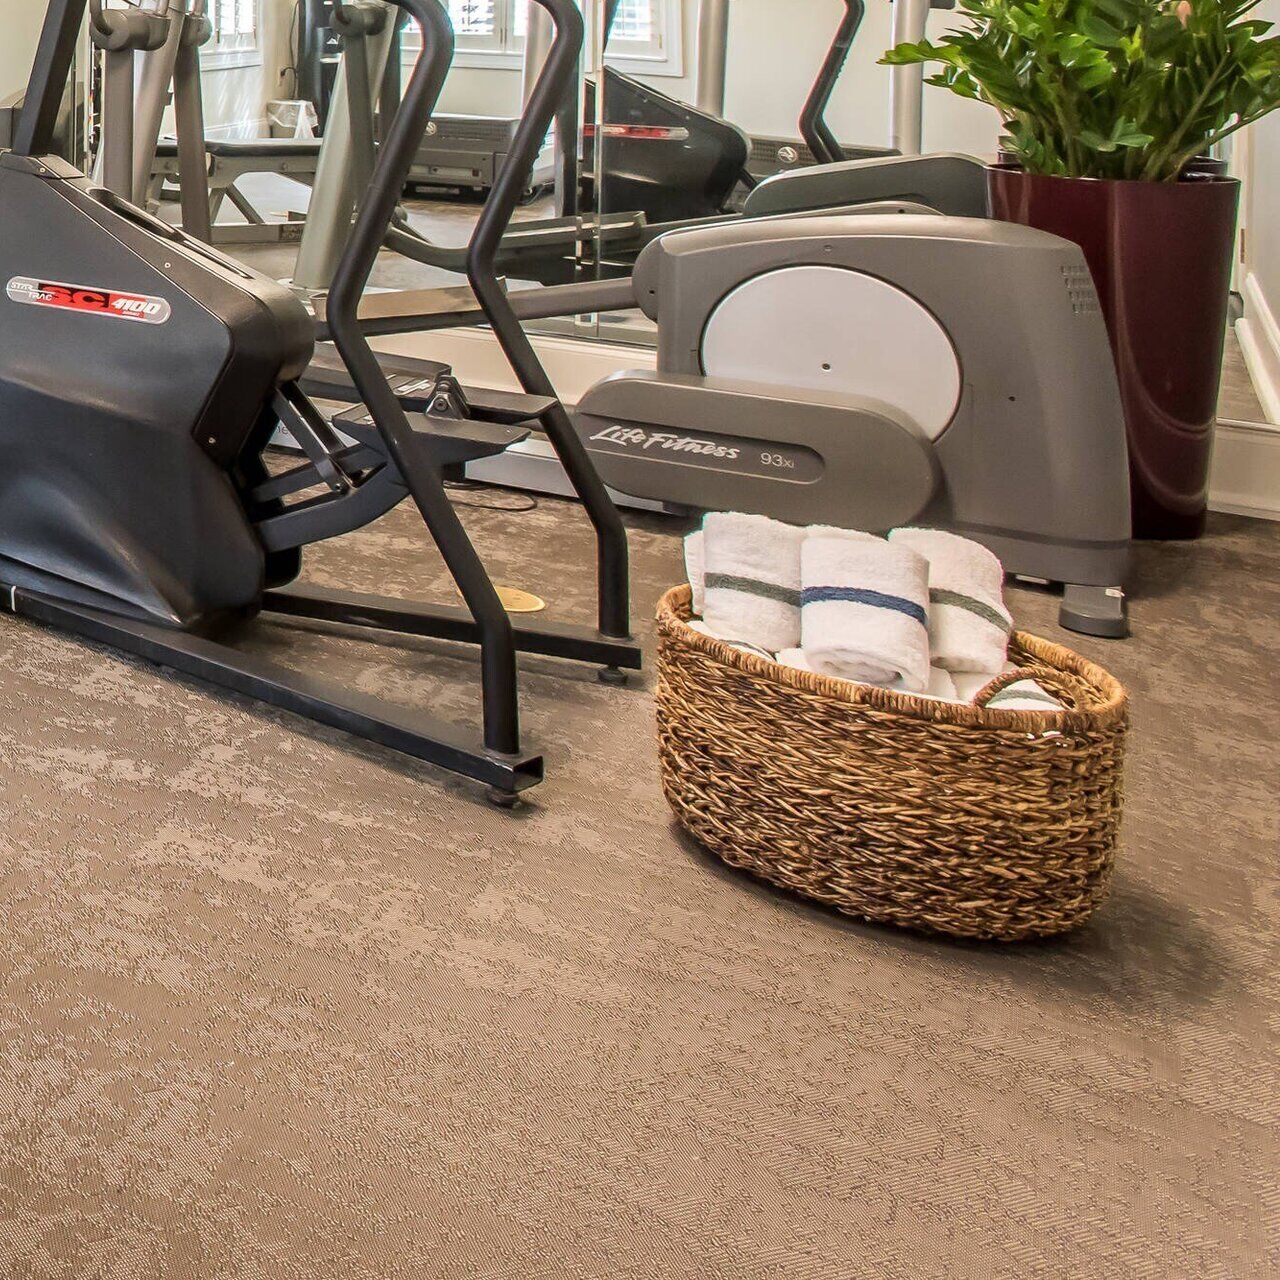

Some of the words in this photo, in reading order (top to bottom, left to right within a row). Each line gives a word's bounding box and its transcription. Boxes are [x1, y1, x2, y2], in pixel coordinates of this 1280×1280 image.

[11, 281, 34, 291] STAR
[27, 291, 53, 302] TRAC
[111, 298, 162, 315] 4100
[589, 425, 647, 446] Life
[643, 432, 740, 459] Fitness
